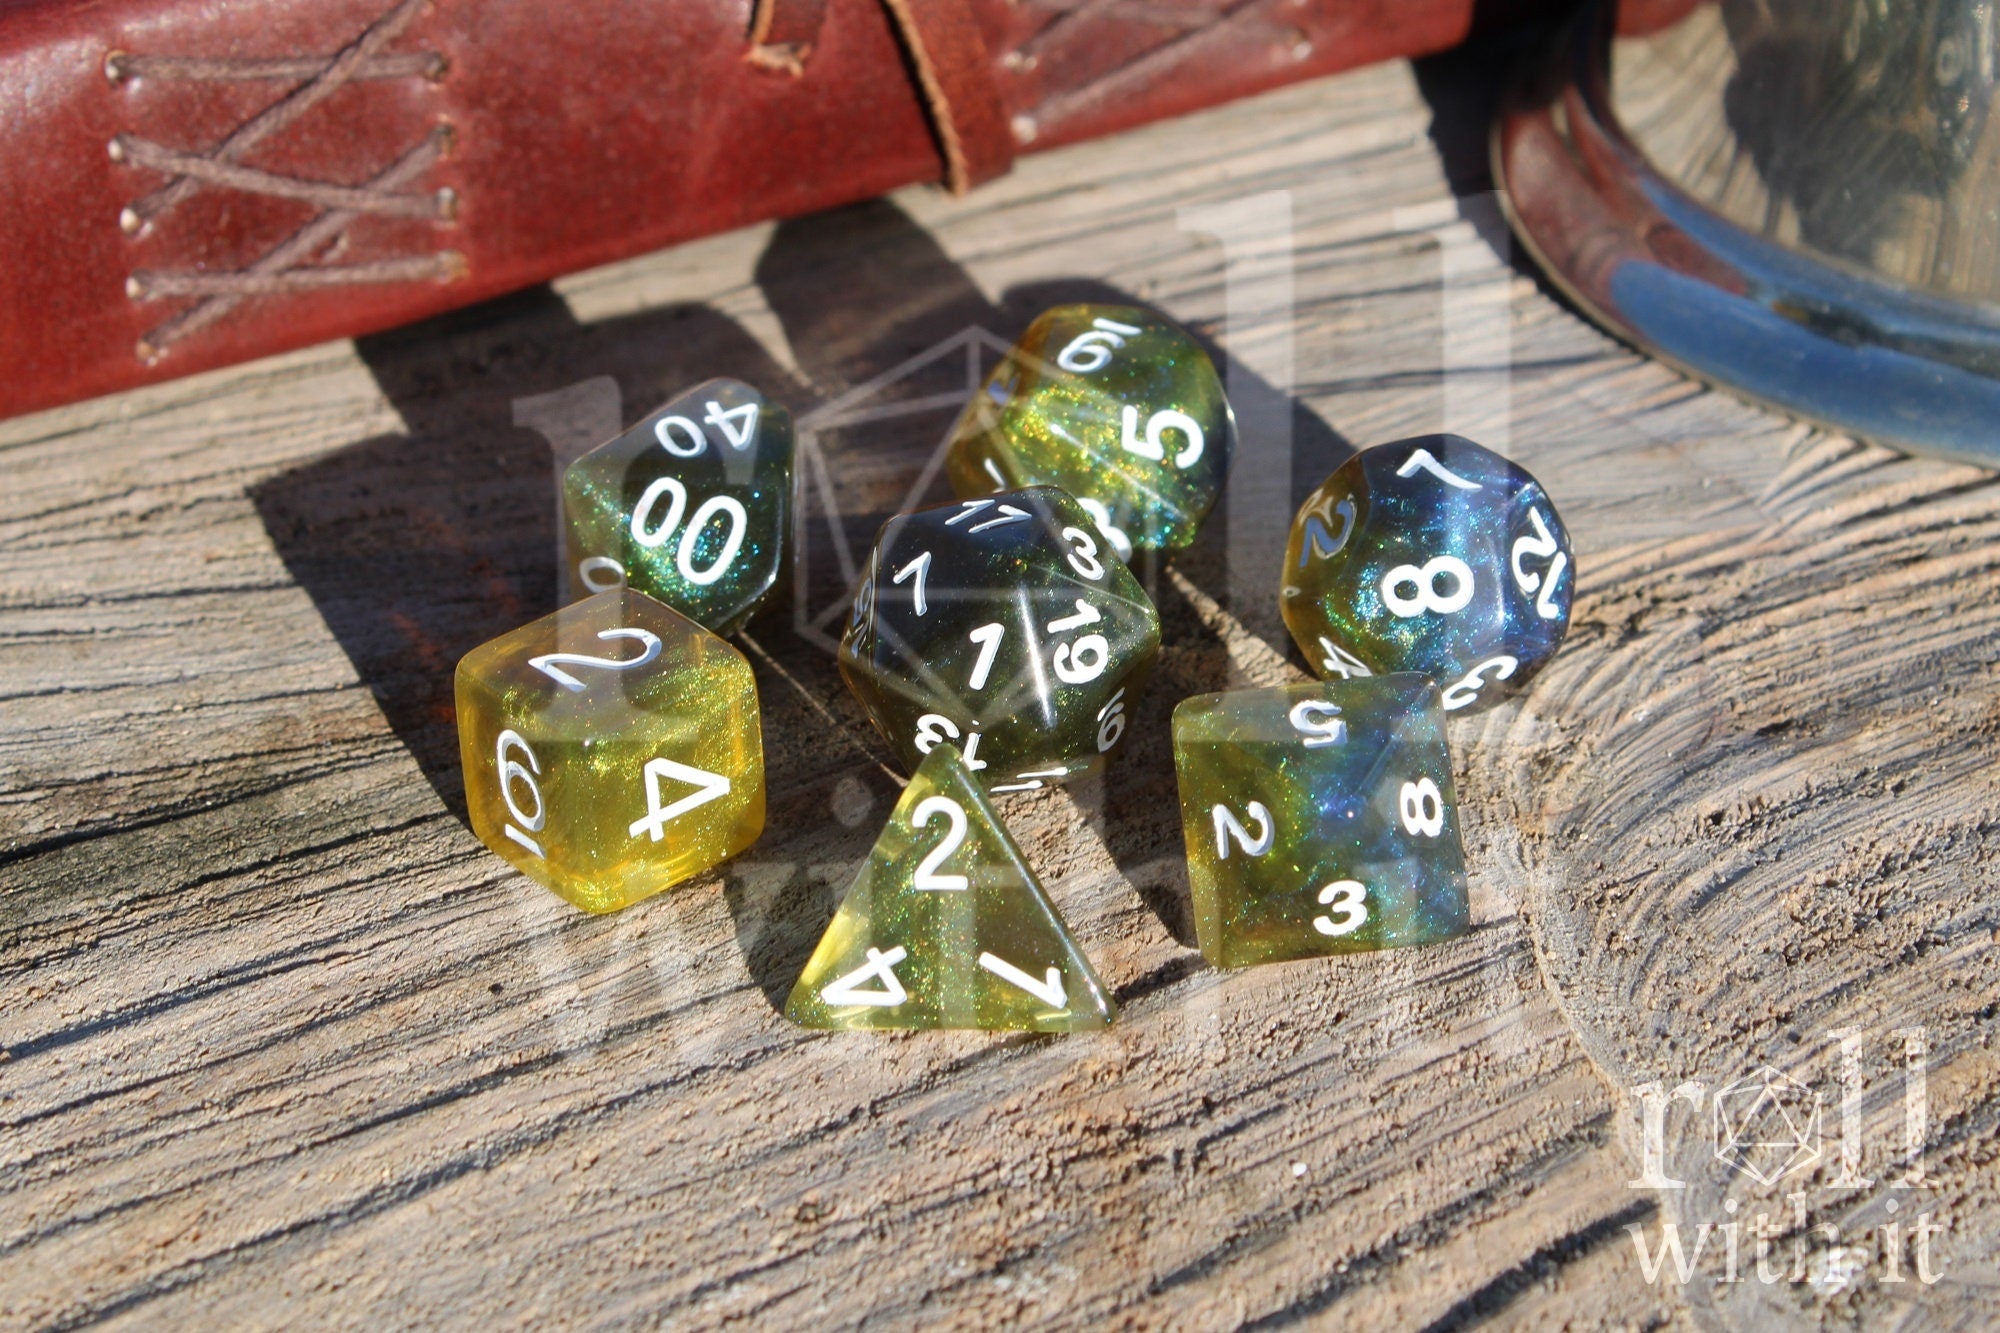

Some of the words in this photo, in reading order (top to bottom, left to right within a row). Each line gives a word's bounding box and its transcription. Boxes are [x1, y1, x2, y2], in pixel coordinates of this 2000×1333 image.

[1122, 405, 1204, 469] 5
[631, 476, 747, 585] 00
[1062, 526, 1105, 580] 3
[1382, 555, 1475, 618] 8
[528, 628, 662, 692] 2
[969, 622, 1005, 690] 1
[1047, 598, 1109, 684] 19
[1443, 655, 1518, 711] 3
[1289, 699, 1347, 748] 5
[629, 757, 730, 842] 4
[1212, 801, 1275, 860] 2
[1400, 777, 1444, 838] 8
[912, 796, 968, 890] 2
[1313, 880, 1367, 936] 3
[821, 945, 907, 1006] 4
